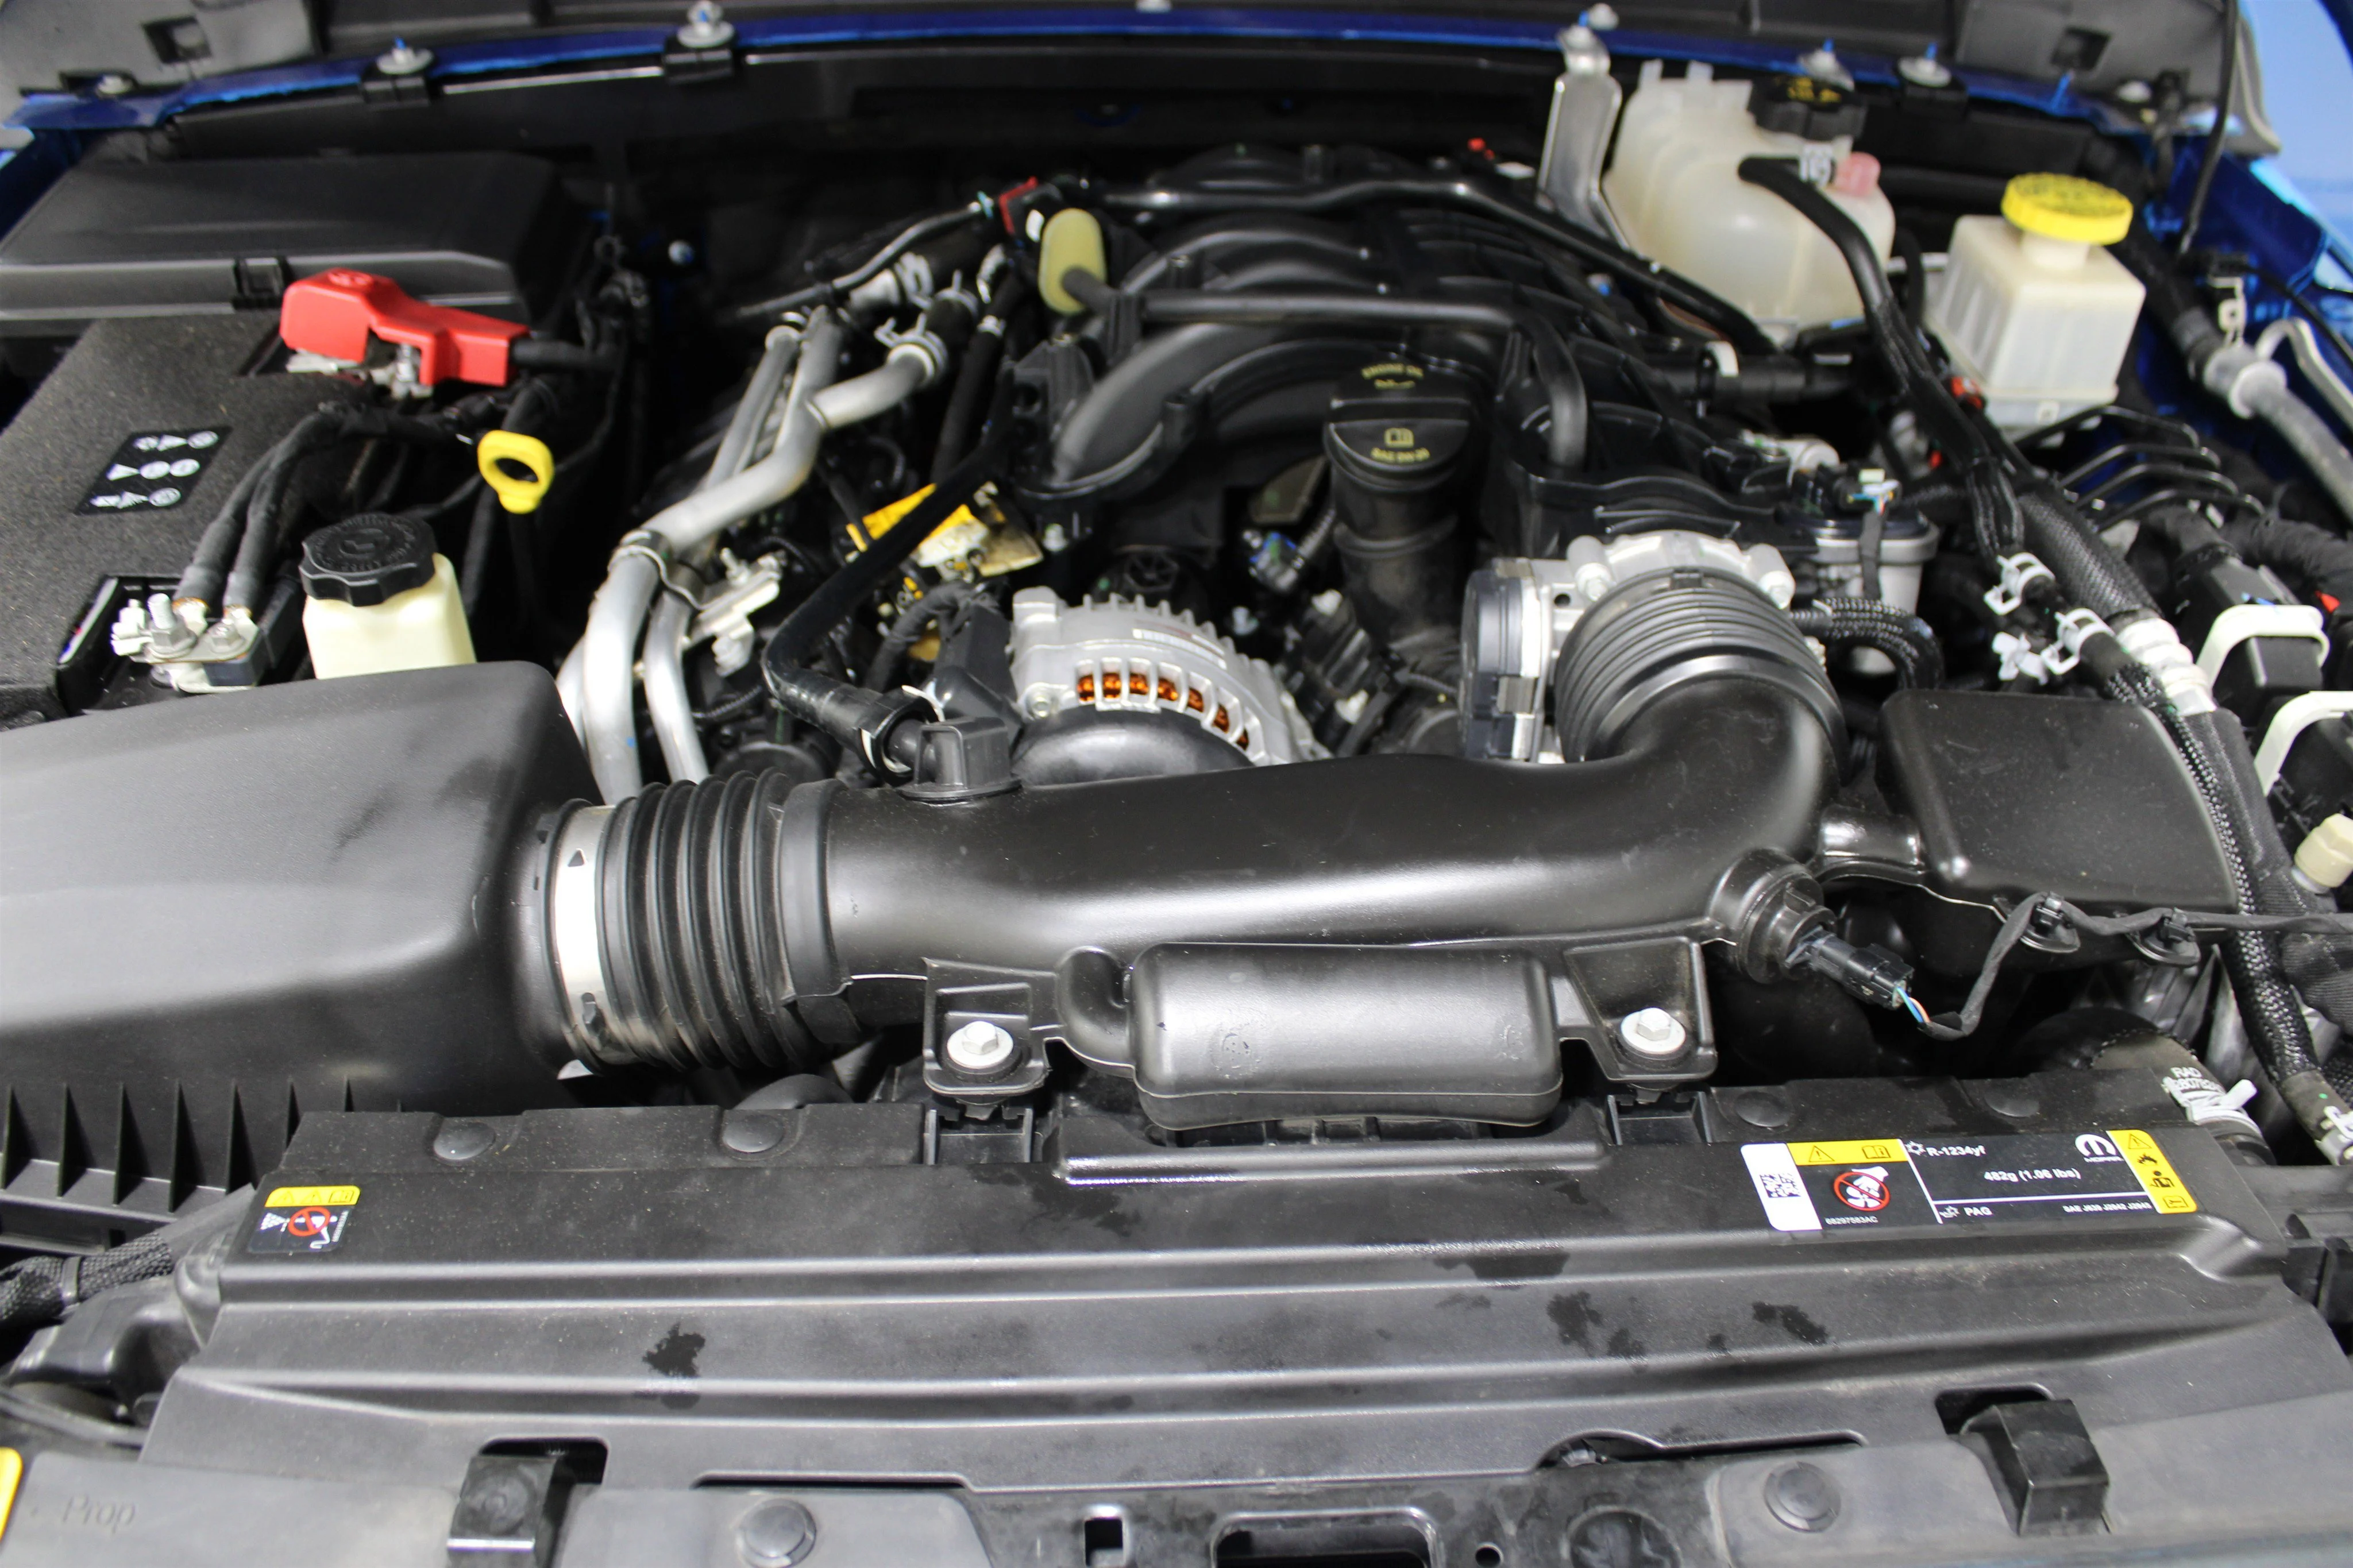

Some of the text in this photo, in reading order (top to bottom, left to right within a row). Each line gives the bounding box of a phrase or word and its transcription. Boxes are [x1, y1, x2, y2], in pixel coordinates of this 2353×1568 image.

[2170, 1066, 2202, 1077] RAD
[1926, 1145, 1986, 1157] R-1234yf
[1984, 1168, 2081, 1182] 482g (1.06 lbs)
[1963, 1206, 1993, 1216] PAG
